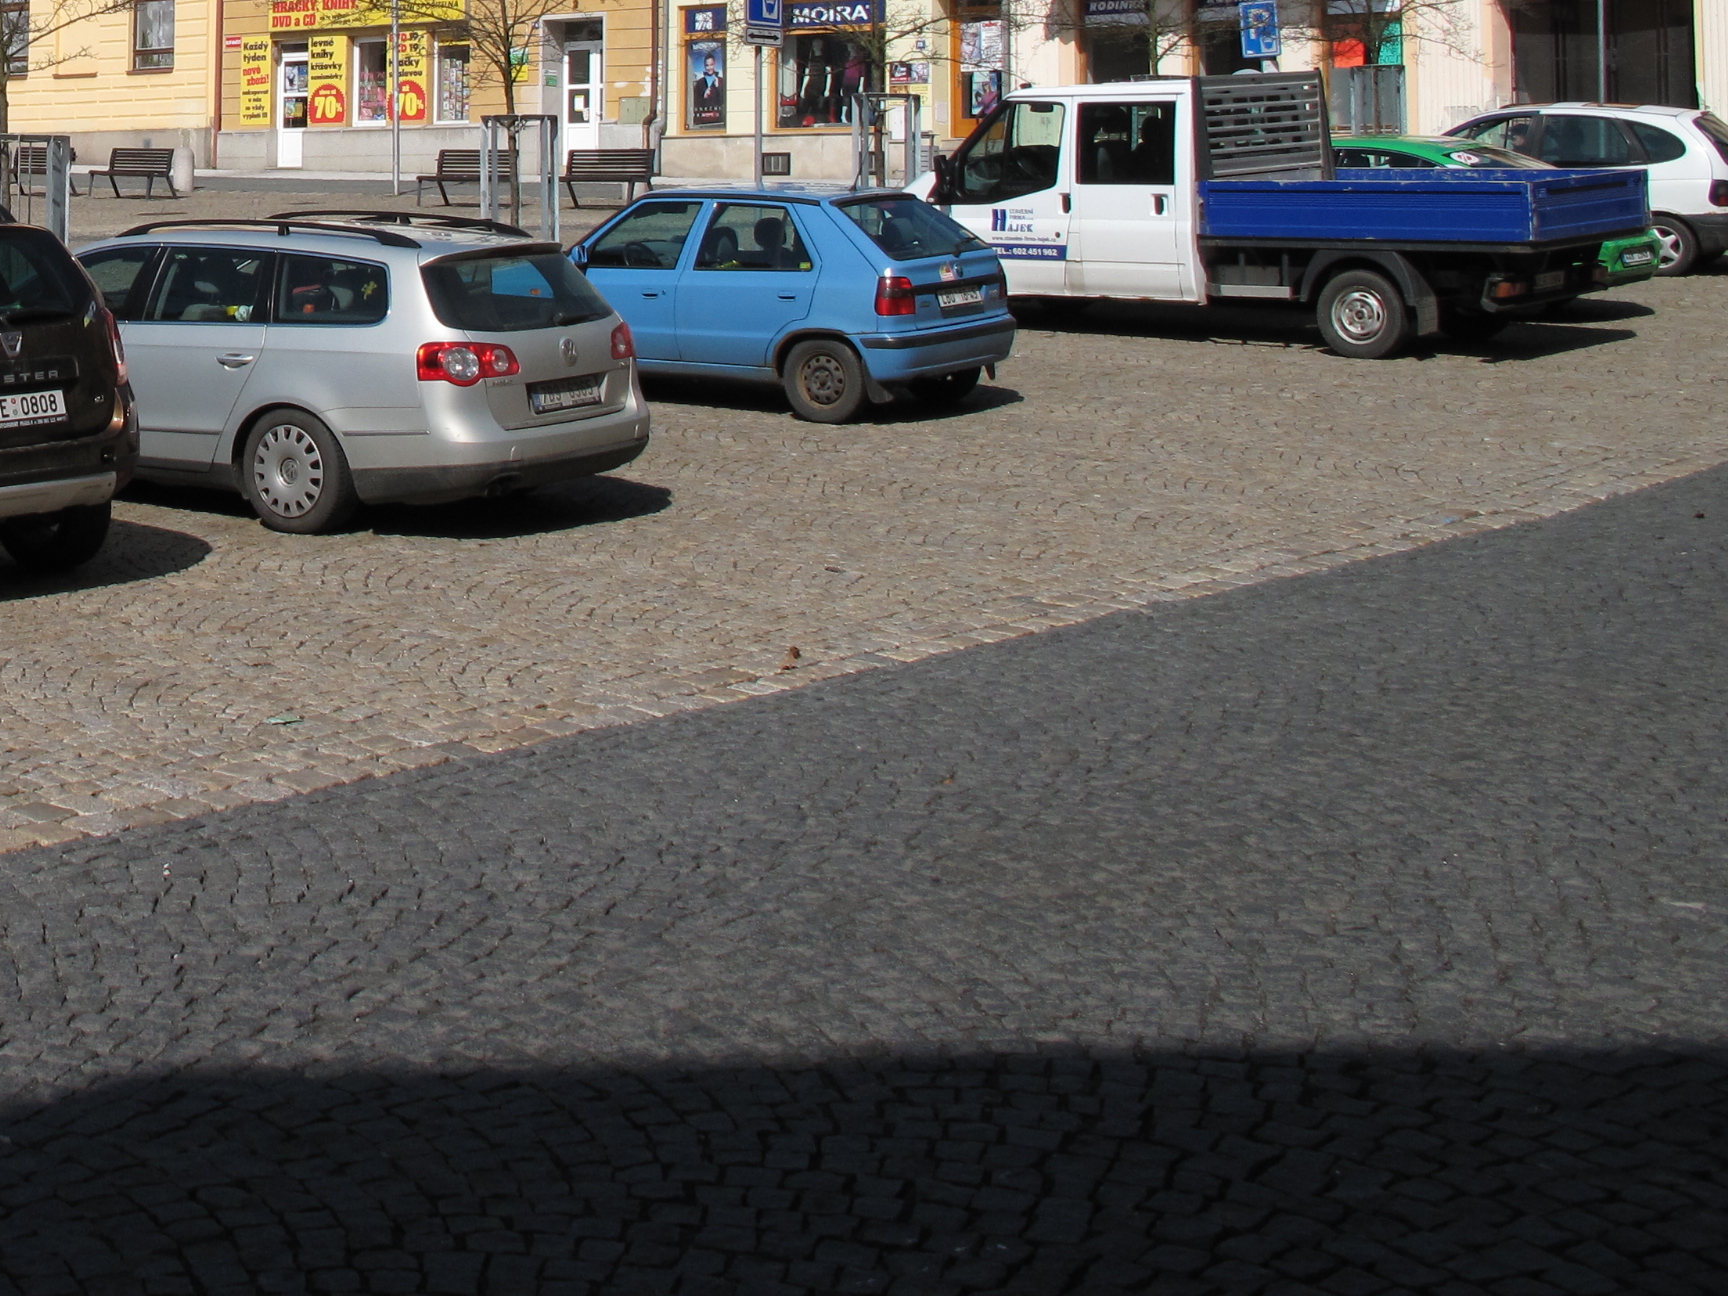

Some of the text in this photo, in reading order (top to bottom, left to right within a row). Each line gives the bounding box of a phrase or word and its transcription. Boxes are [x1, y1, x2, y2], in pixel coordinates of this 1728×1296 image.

[792, 5, 869, 24] MOIRA
[272, 16, 291, 28] DVD
[294, 18, 300, 26] a
[303, 14, 316, 26] CD
[310, 37, 334, 47] levné
[389, 32, 406, 43] DD
[243, 40, 269, 51] Každý
[243, 53, 267, 64] týden
[310, 50, 334, 60] knihy
[389, 57, 420, 68] Hačky
[1012, 247, 1027, 255] 602
[21, 394, 58, 415] 0808
